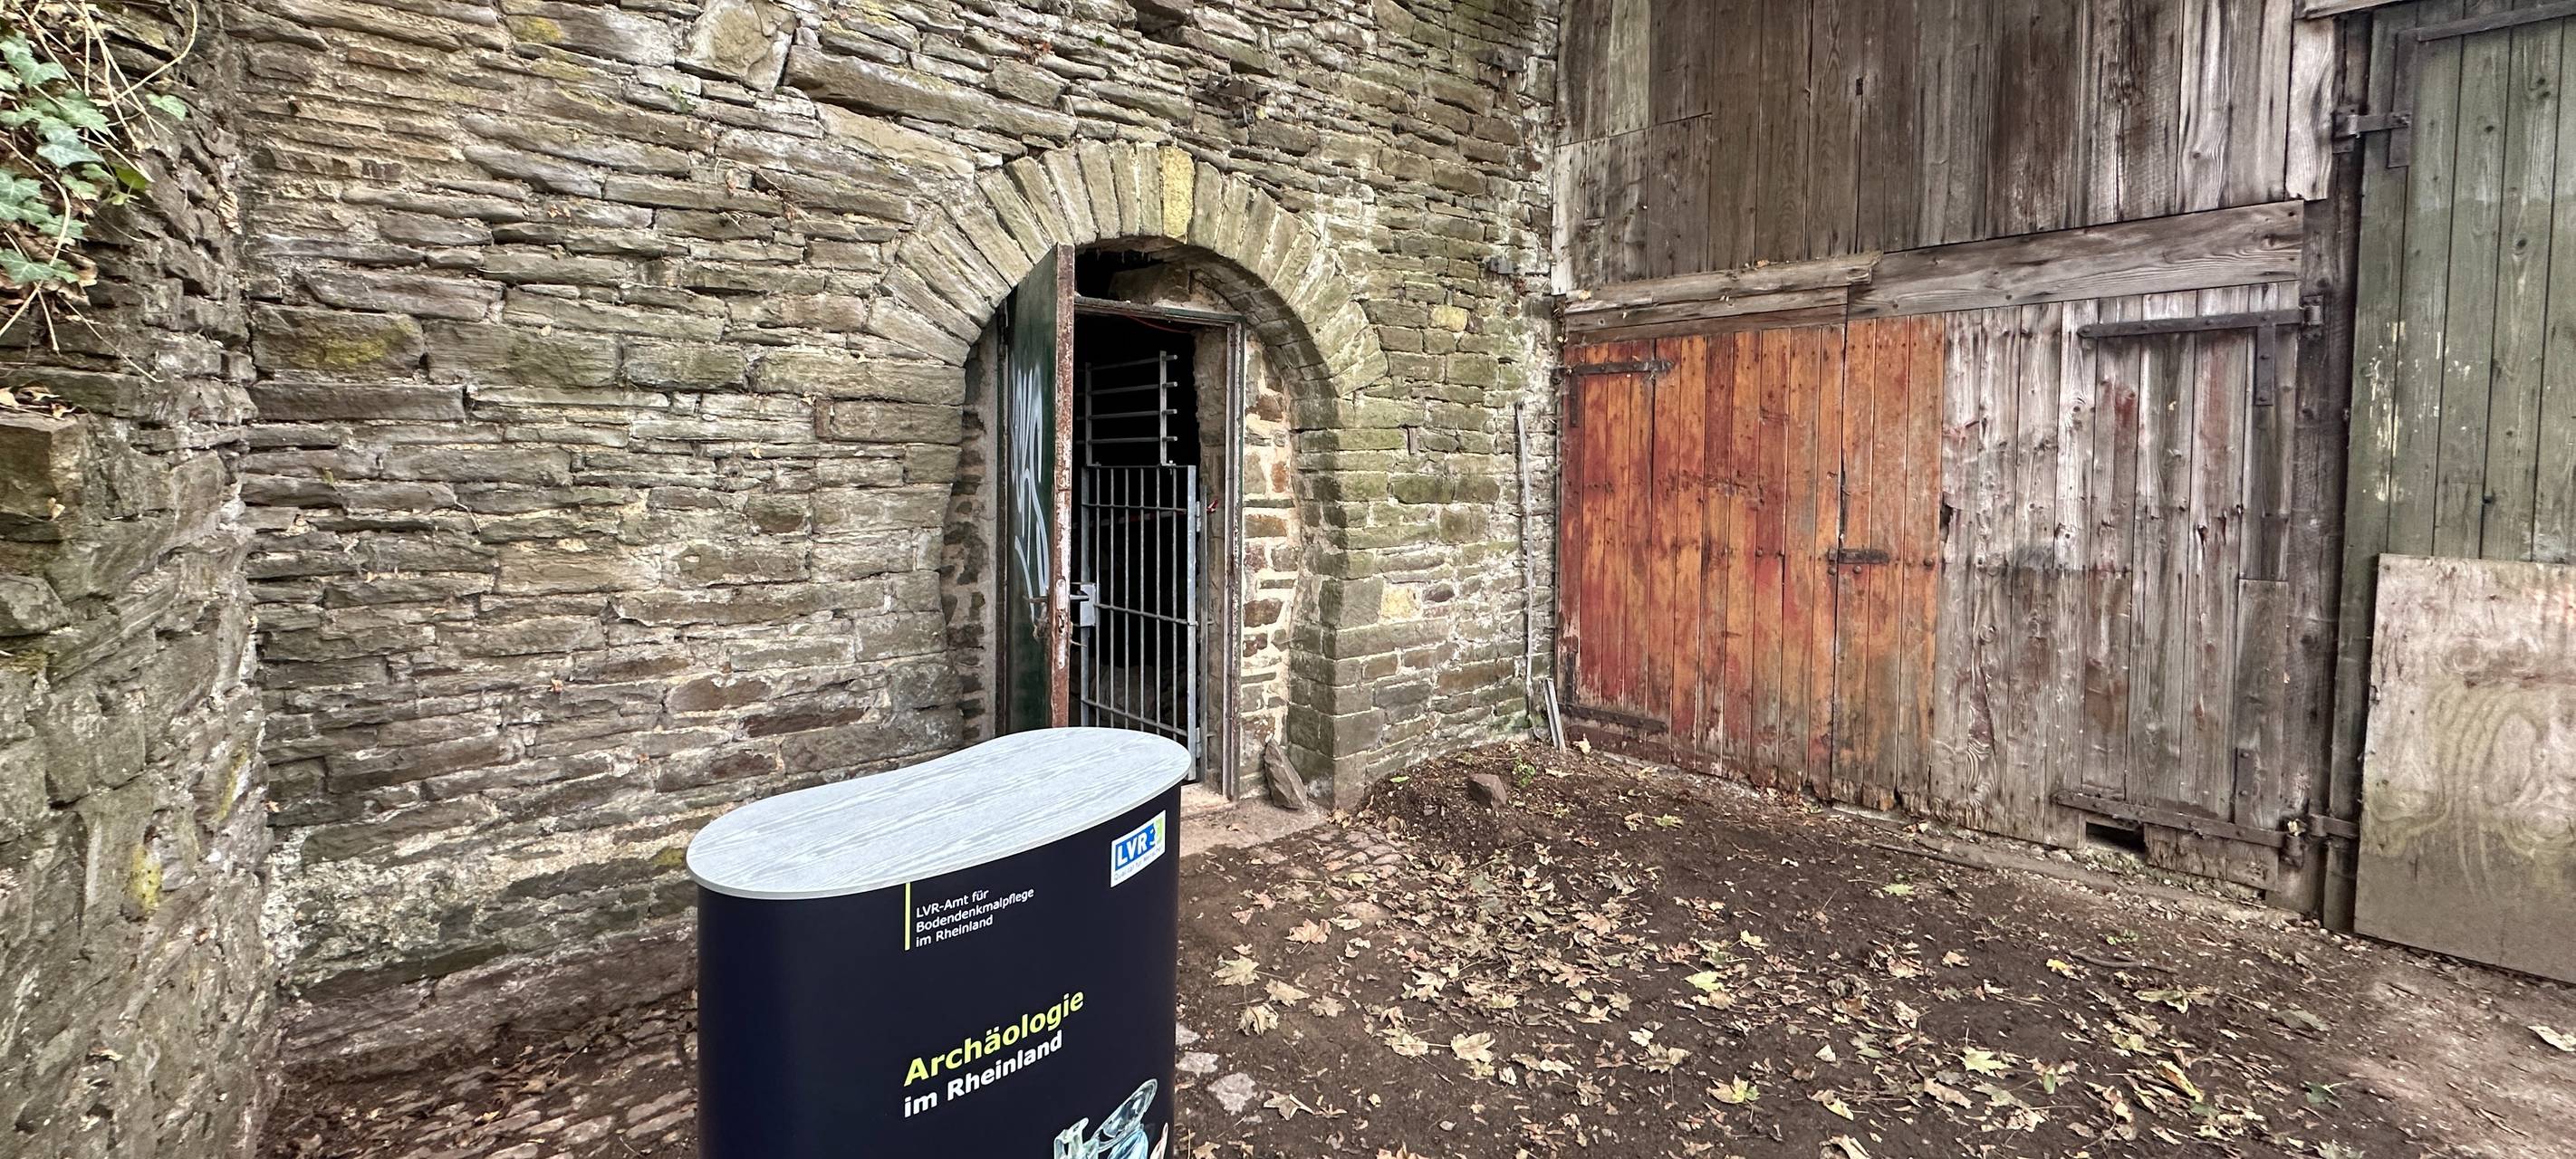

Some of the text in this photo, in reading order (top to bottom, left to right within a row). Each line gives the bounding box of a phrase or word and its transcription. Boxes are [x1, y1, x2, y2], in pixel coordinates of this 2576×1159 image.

[1117, 832, 1148, 867] LVR
[916, 889, 989, 918] LVR-Amt für
[916, 888, 1034, 933] Bodendenkmalpflege
[916, 914, 994, 947] im Rheinland
[903, 991, 1084, 1087] Archäologie
[904, 1029, 1062, 1118] im Rheinland
